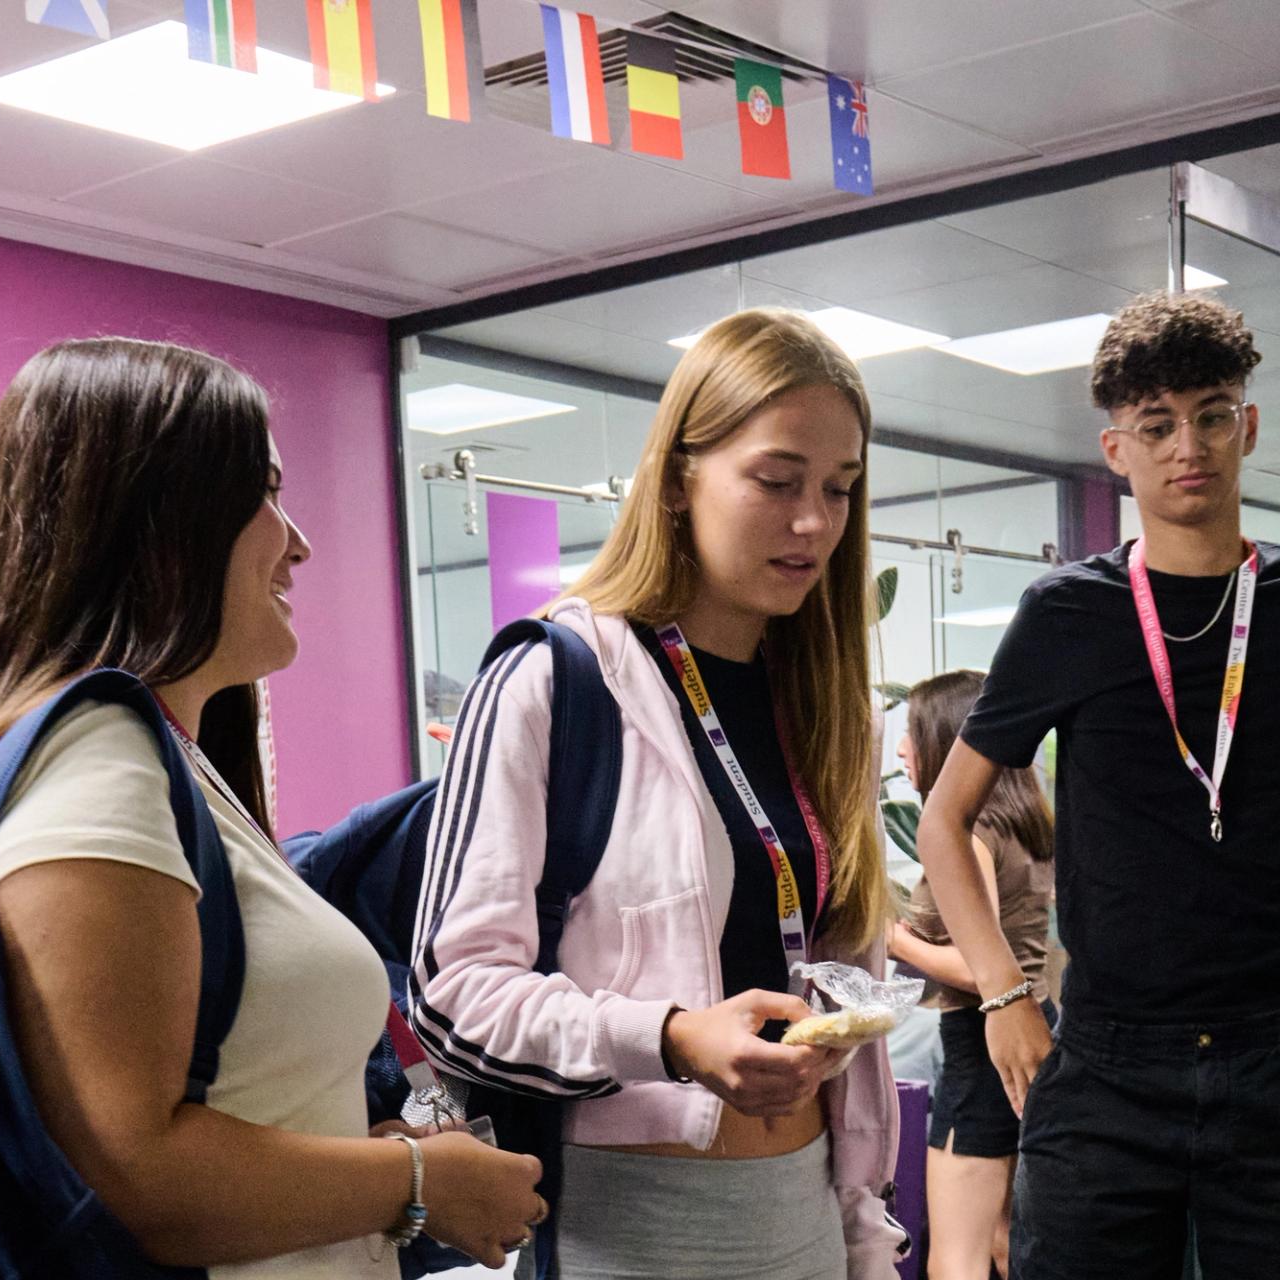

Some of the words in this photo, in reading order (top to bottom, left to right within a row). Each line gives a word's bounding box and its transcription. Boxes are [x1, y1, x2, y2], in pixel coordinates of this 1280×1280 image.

[680, 656, 712, 718] Student
[726, 759, 761, 816] Student
[778, 857, 797, 919] Student
